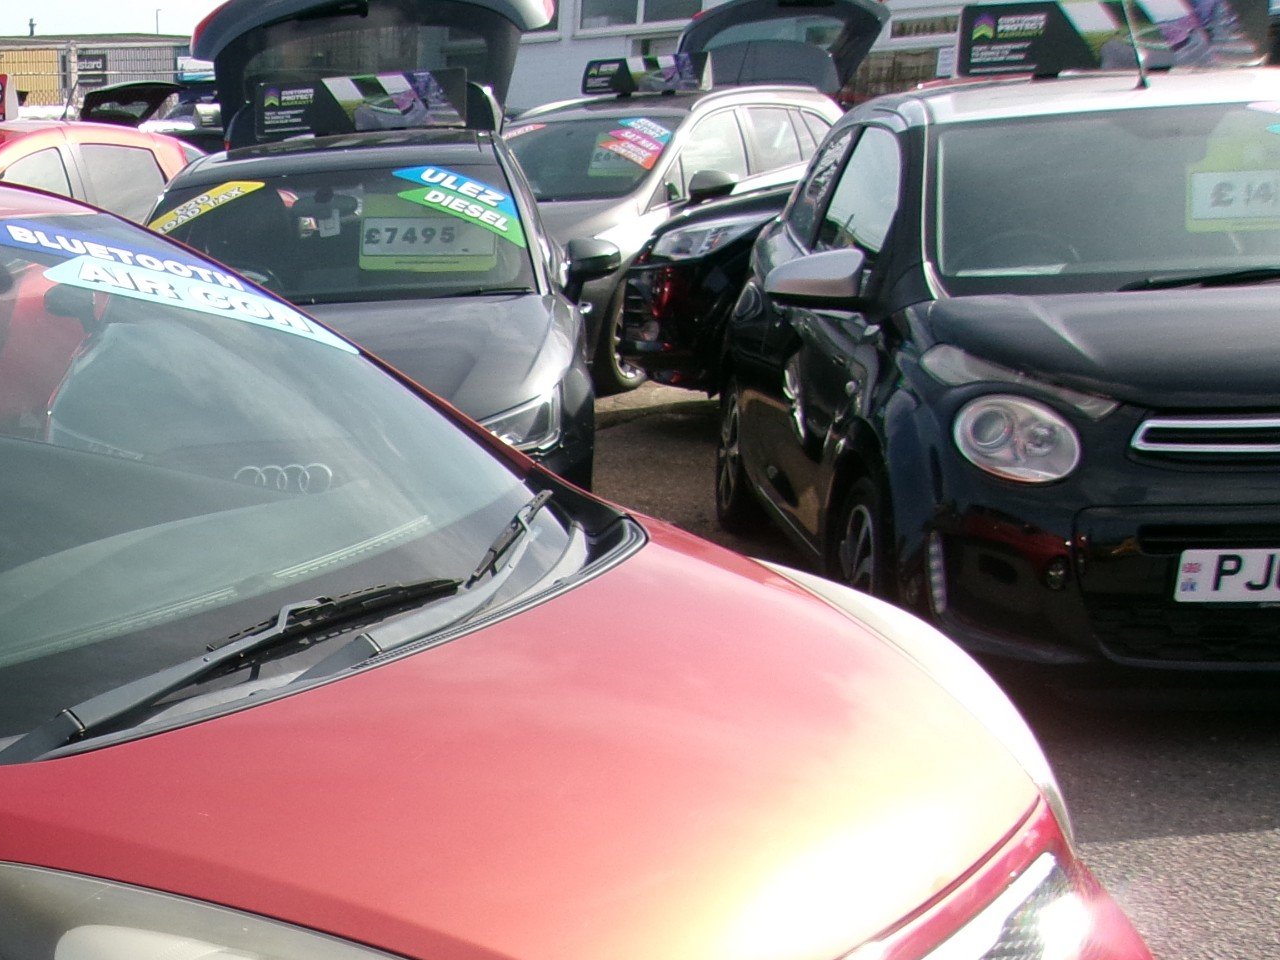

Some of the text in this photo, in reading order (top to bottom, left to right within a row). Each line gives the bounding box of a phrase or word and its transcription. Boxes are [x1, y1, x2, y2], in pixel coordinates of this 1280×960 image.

[78, 58, 103, 70] stard
[420, 168, 505, 208] ULEZ
[423, 190, 508, 232] DIESEL
[364, 226, 457, 245] £7495
[5, 225, 248, 292] BLUETOOTH
[77, 260, 315, 334] AIR CON
[1211, 553, 1280, 591] PJ
